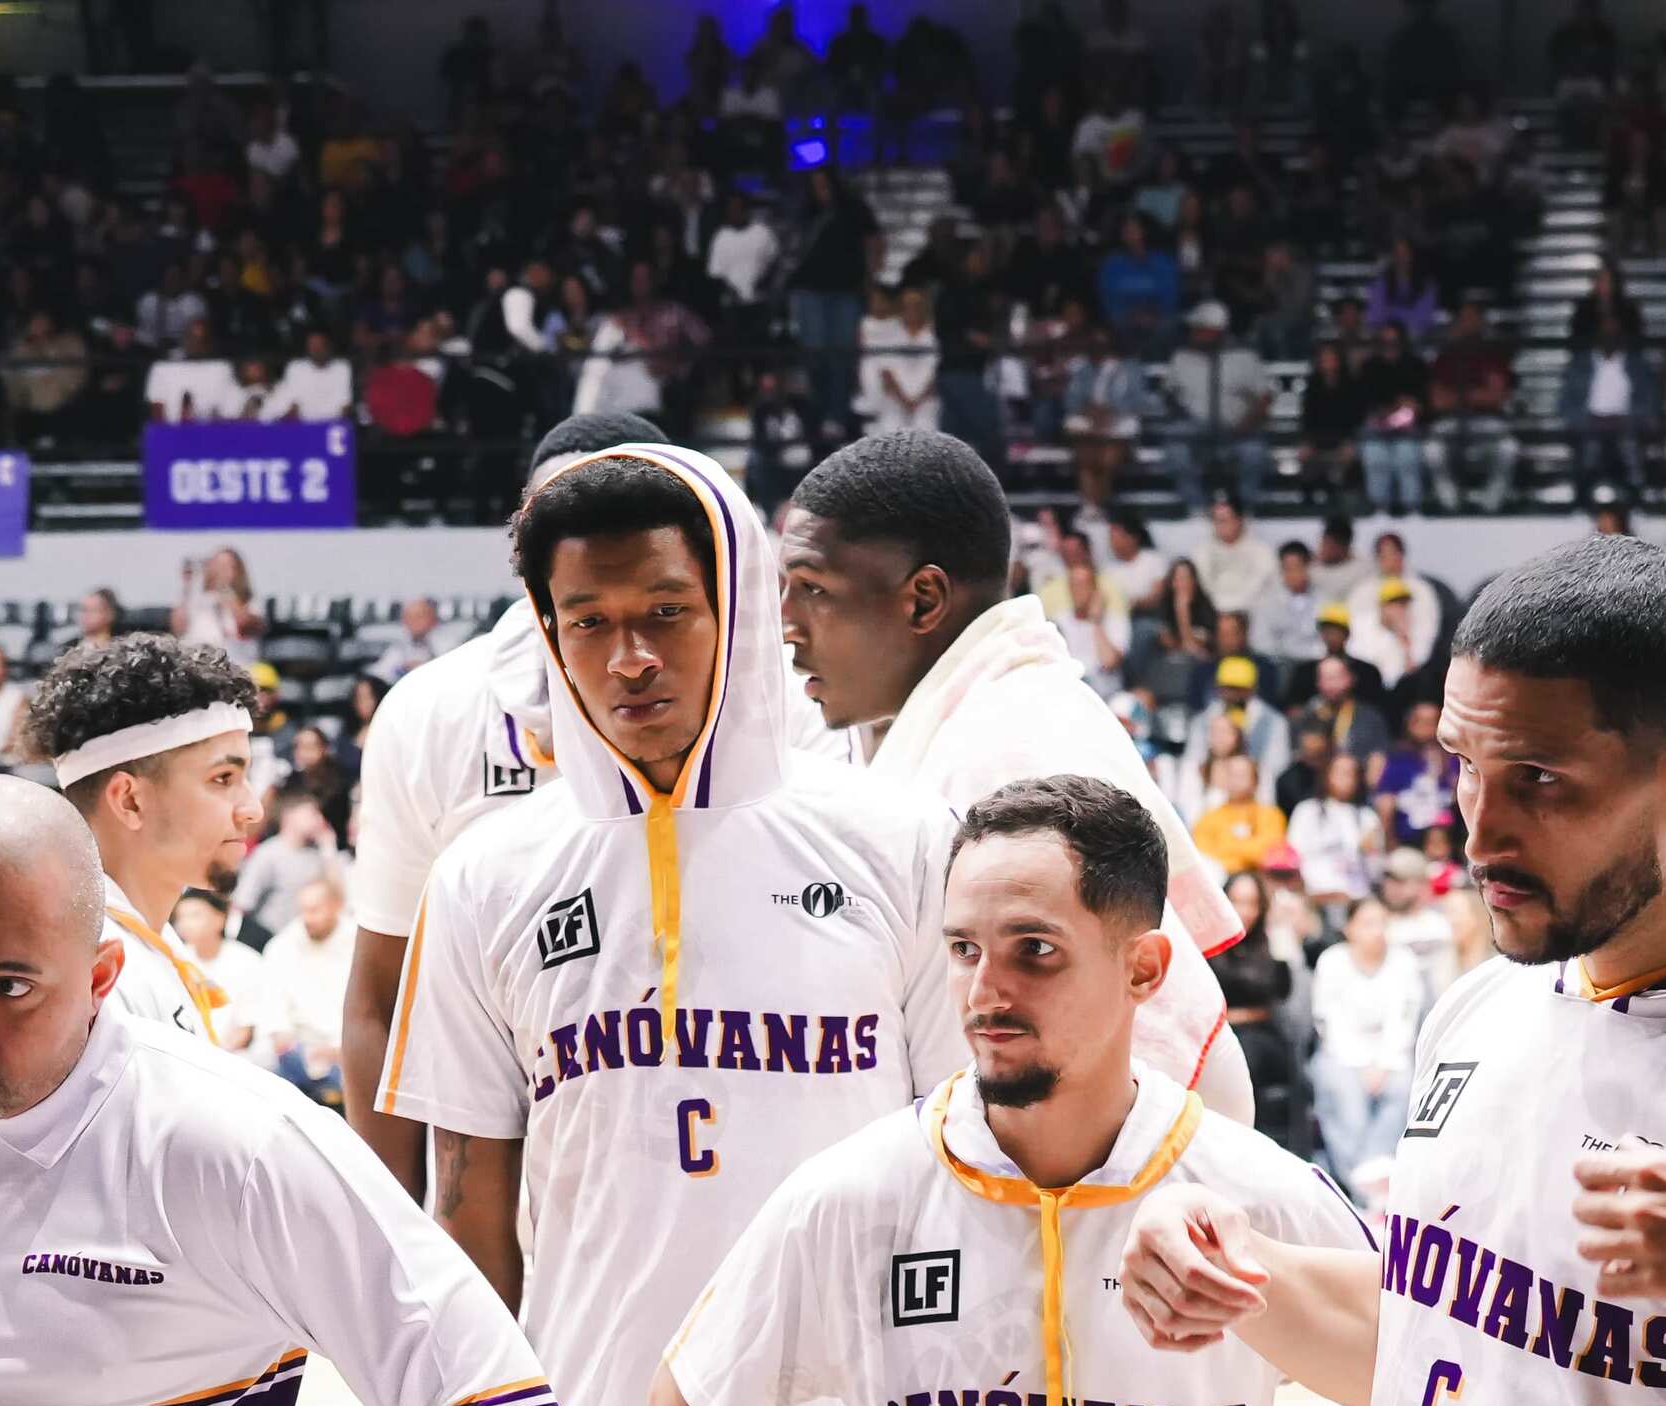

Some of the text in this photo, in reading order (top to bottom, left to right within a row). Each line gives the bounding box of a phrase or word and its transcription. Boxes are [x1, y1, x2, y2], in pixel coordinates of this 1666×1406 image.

[170, 458, 329, 504] OESTE 2
[771, 894, 799, 905] THE
[676, 1098, 721, 1179] C
